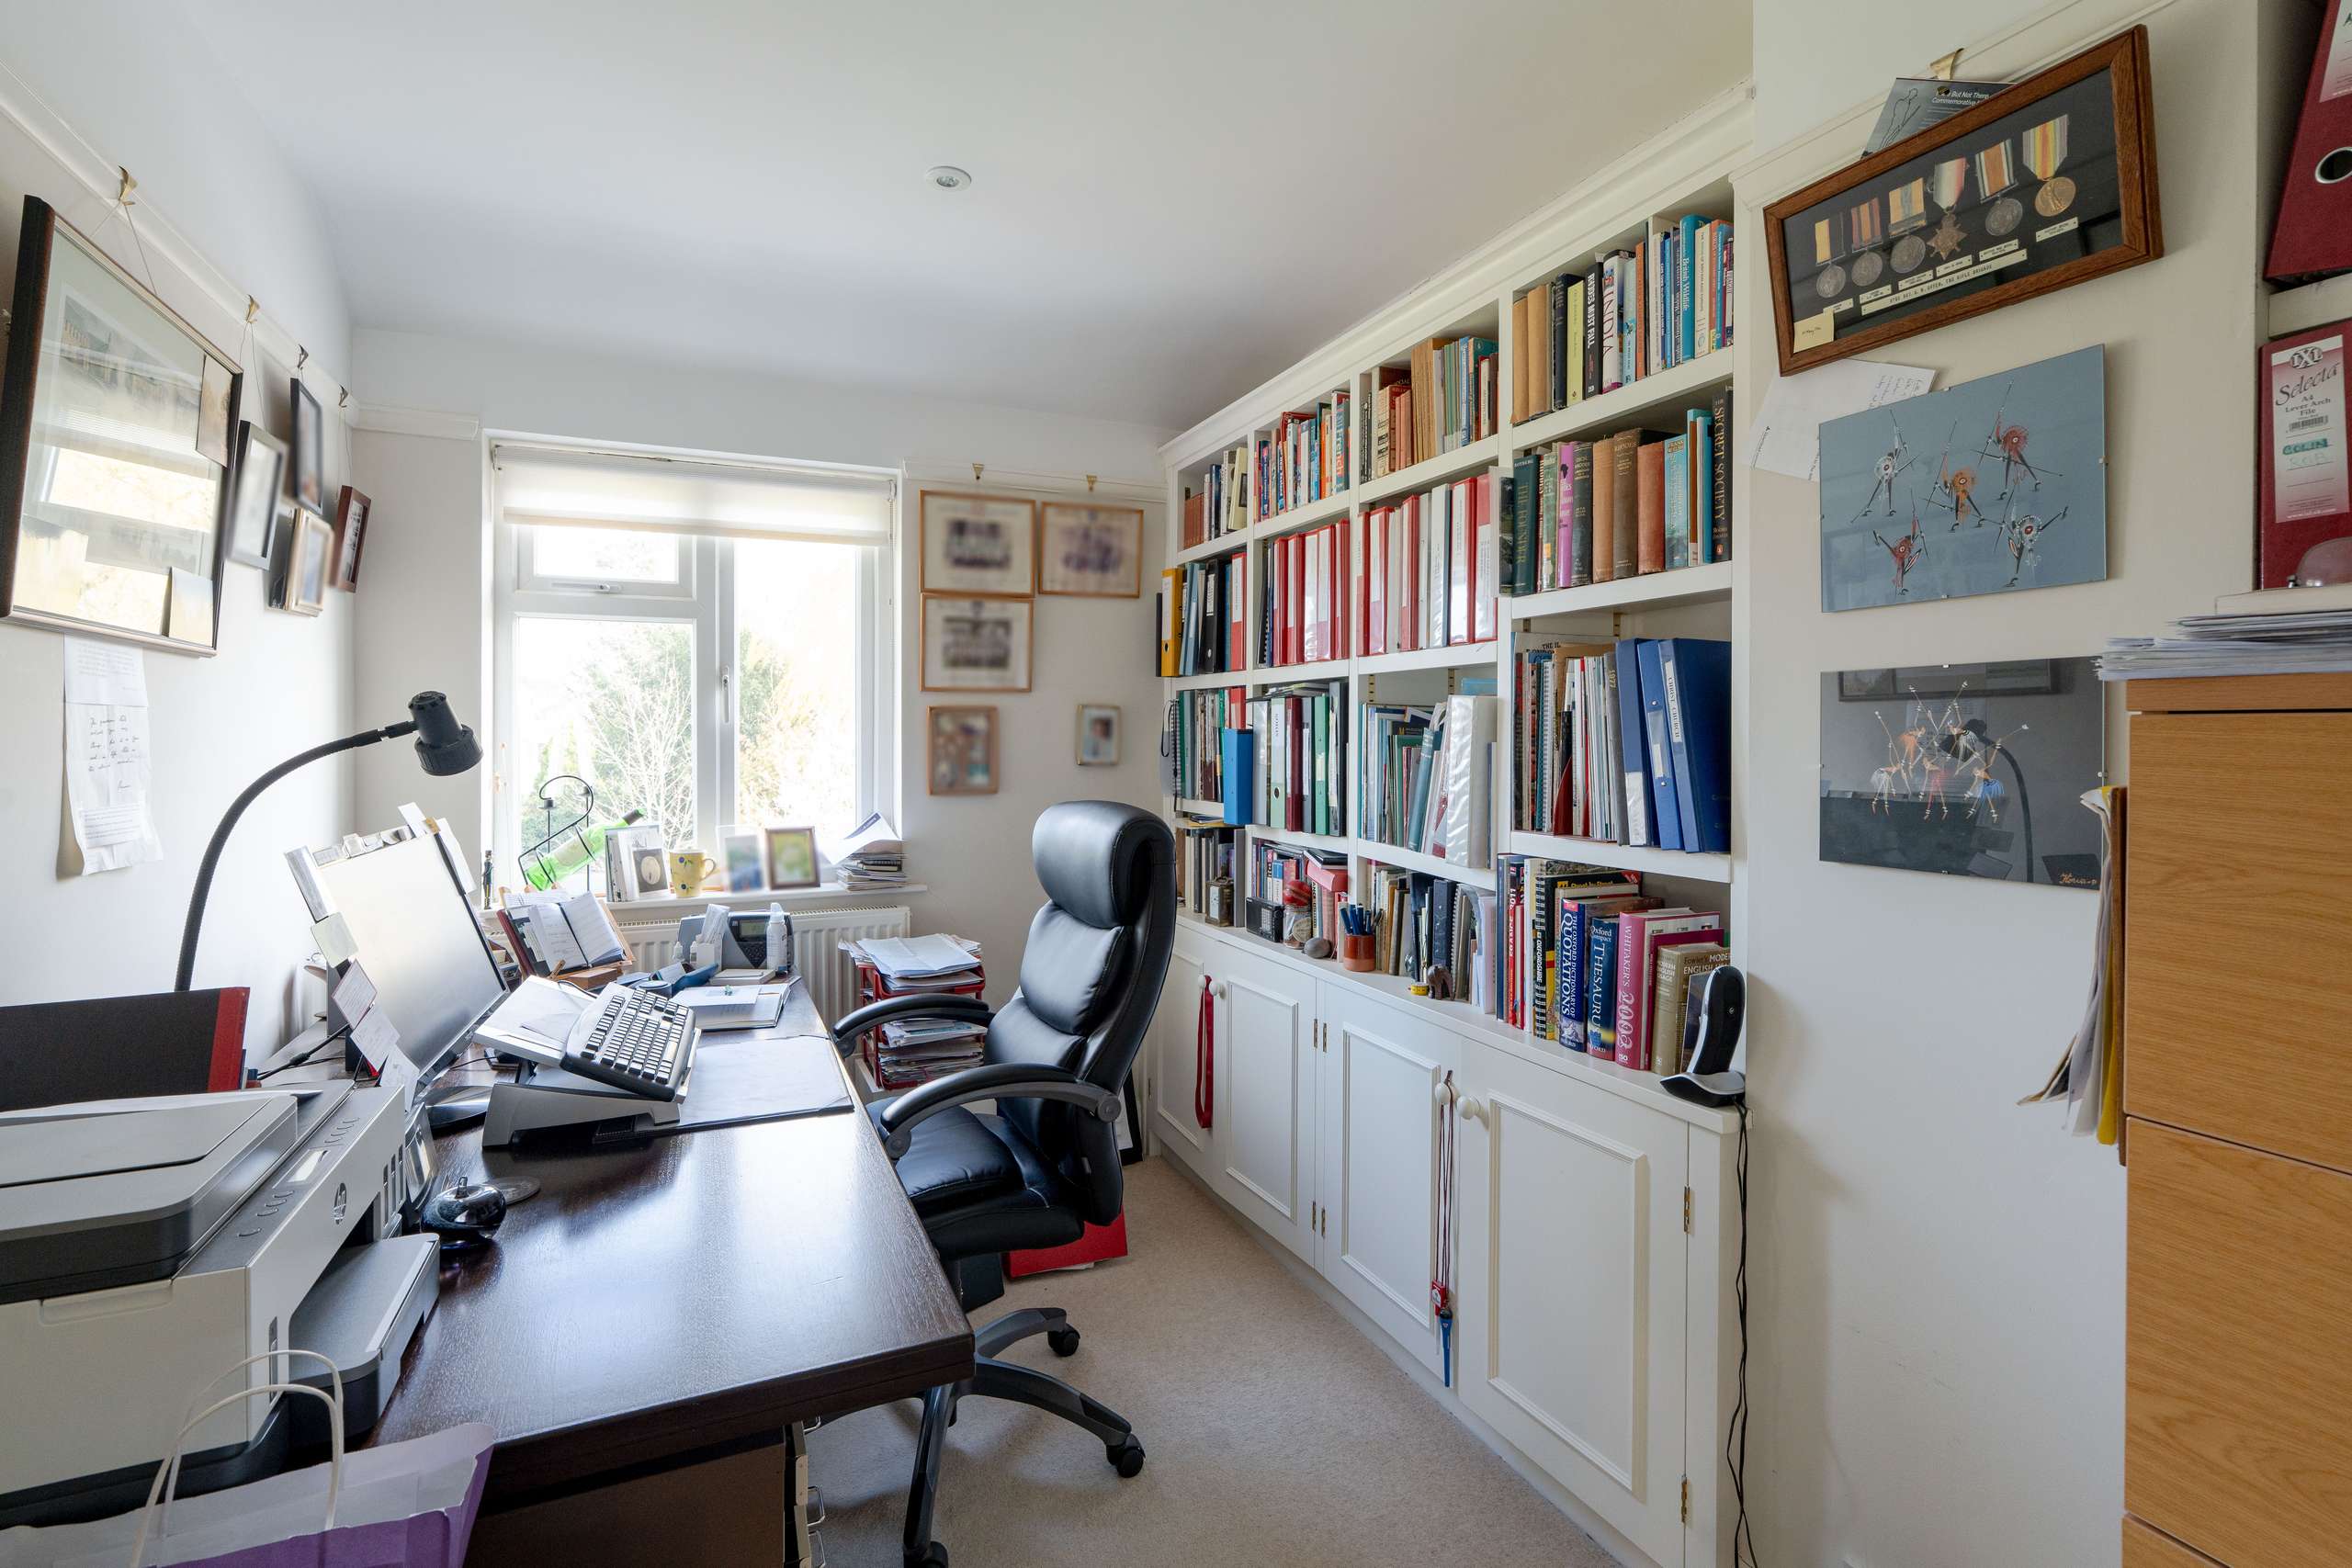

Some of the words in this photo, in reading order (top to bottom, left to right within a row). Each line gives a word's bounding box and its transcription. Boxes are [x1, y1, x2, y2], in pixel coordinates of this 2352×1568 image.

[1681, 257, 1690, 282] British
[1587, 272, 1596, 306] RHODES
[1681, 283, 1690, 311] Wildlife
[1587, 306, 1596, 327] MUST
[1602, 291, 1615, 359] INDIA
[1587, 328, 1596, 349] FALL
[2275, 362, 2341, 407] Selecta
[2285, 403, 2310, 413] Lever
[2311, 398, 2331, 407] Arch
[2300, 409, 2316, 417] File
[1713, 407, 1725, 459] SECRET
[1337, 429, 1345, 475] French
[1517, 484, 1530, 506] THE
[1713, 462, 1726, 521] SOCIETY
[1517, 510, 1530, 564] FOUNDER
[1668, 677, 1676, 703] CHRIST
[1670, 706, 1680, 739] CHURCH
[1589, 924, 1612, 938] Oxford
[1535, 939, 1544, 984] OXFORDSHIRE
[1560, 911, 1573, 1016] QUOTATIONS
[1622, 924, 1633, 987] WHITAKER'S
[1683, 964, 1713, 976] ENGLISH
[1569, 1007, 1576, 1018] OF
